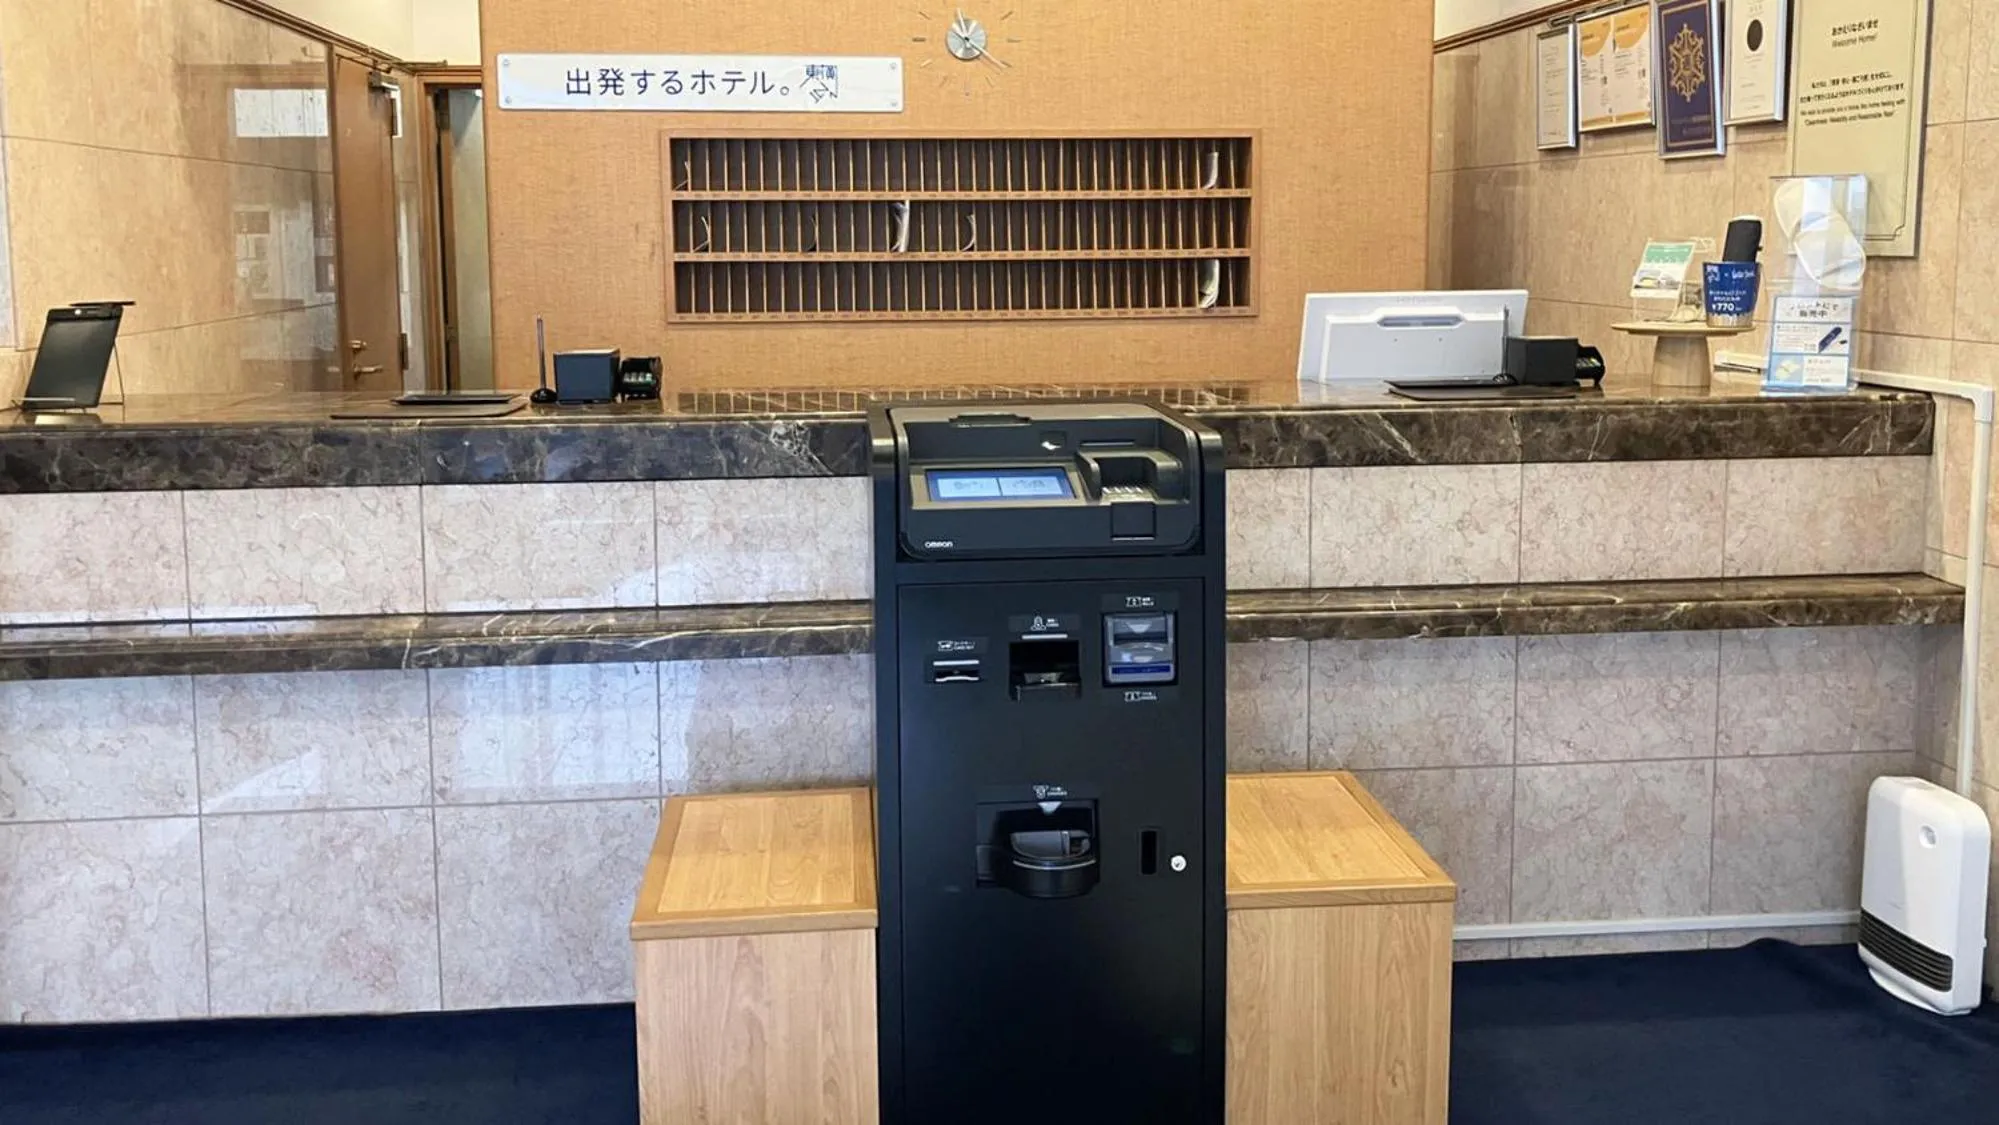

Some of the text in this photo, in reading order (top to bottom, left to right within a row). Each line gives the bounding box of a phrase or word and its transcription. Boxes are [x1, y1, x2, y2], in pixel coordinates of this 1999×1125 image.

[566, 67, 790, 96] 出発するホテル。
